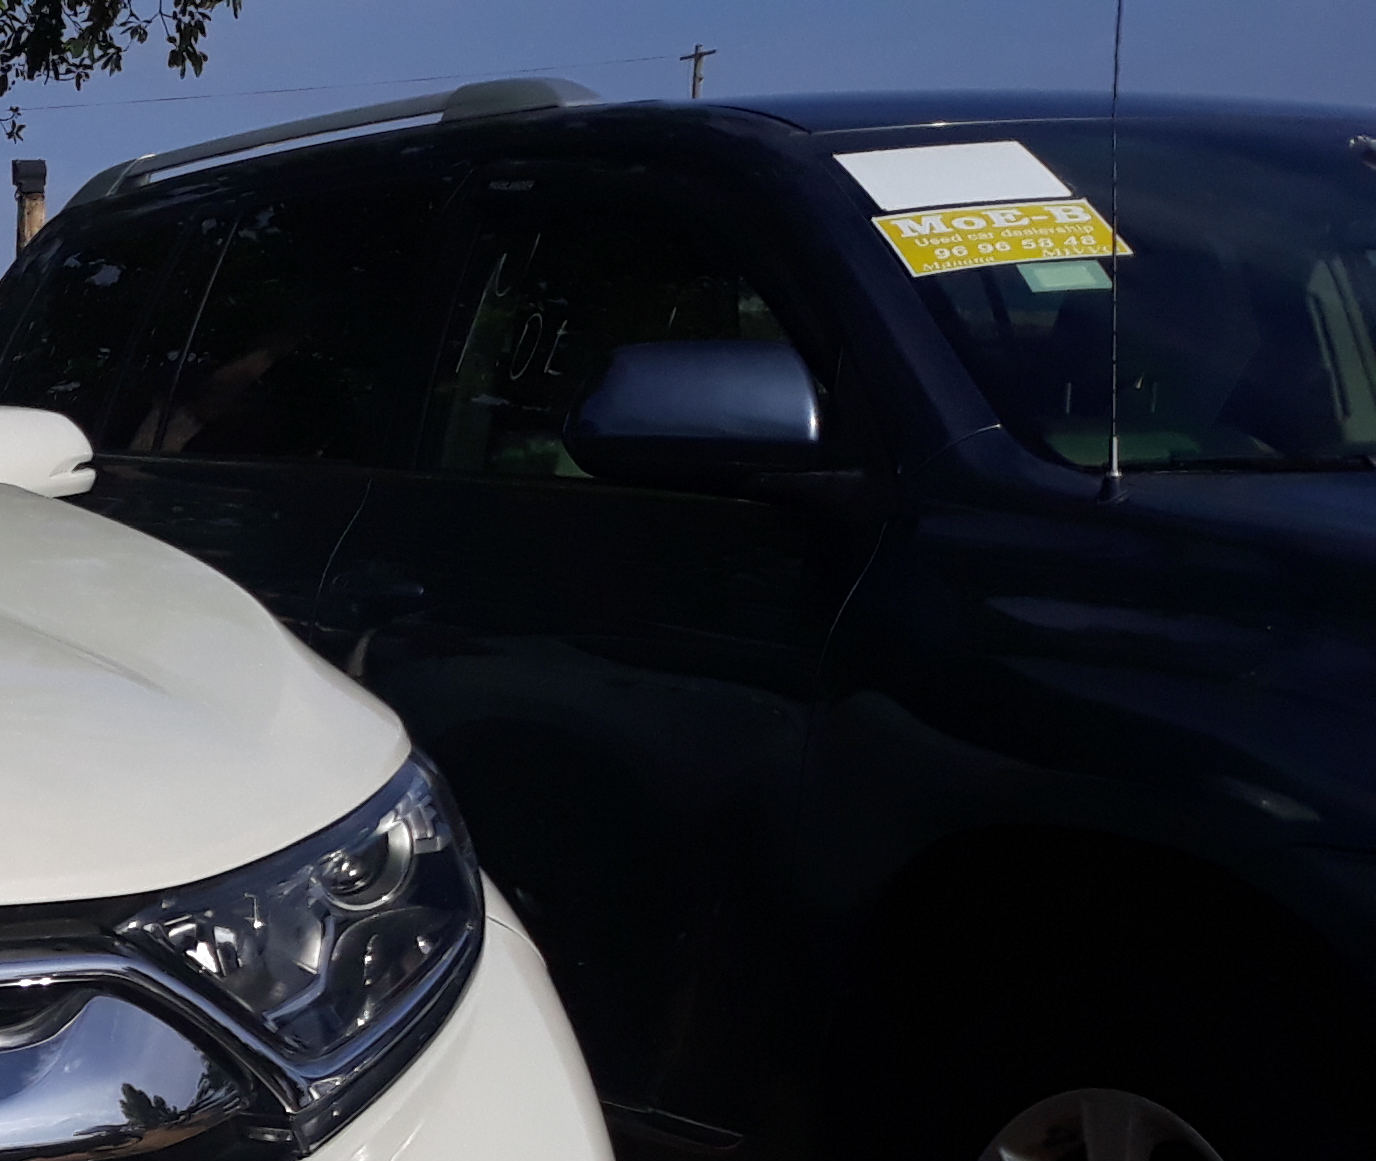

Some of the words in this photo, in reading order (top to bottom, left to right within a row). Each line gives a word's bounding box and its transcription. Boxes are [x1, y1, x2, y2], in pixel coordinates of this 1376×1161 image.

[891, 206, 1092, 238] MoE-B
[915, 234, 963, 247] Used
[967, 232, 995, 241] car
[1001, 225, 1095, 238] dealership
[934, 245, 968, 259] 96
[977, 241, 1011, 254] 96
[1021, 238, 1054, 249] 58
[1063, 235, 1097, 246] 48
